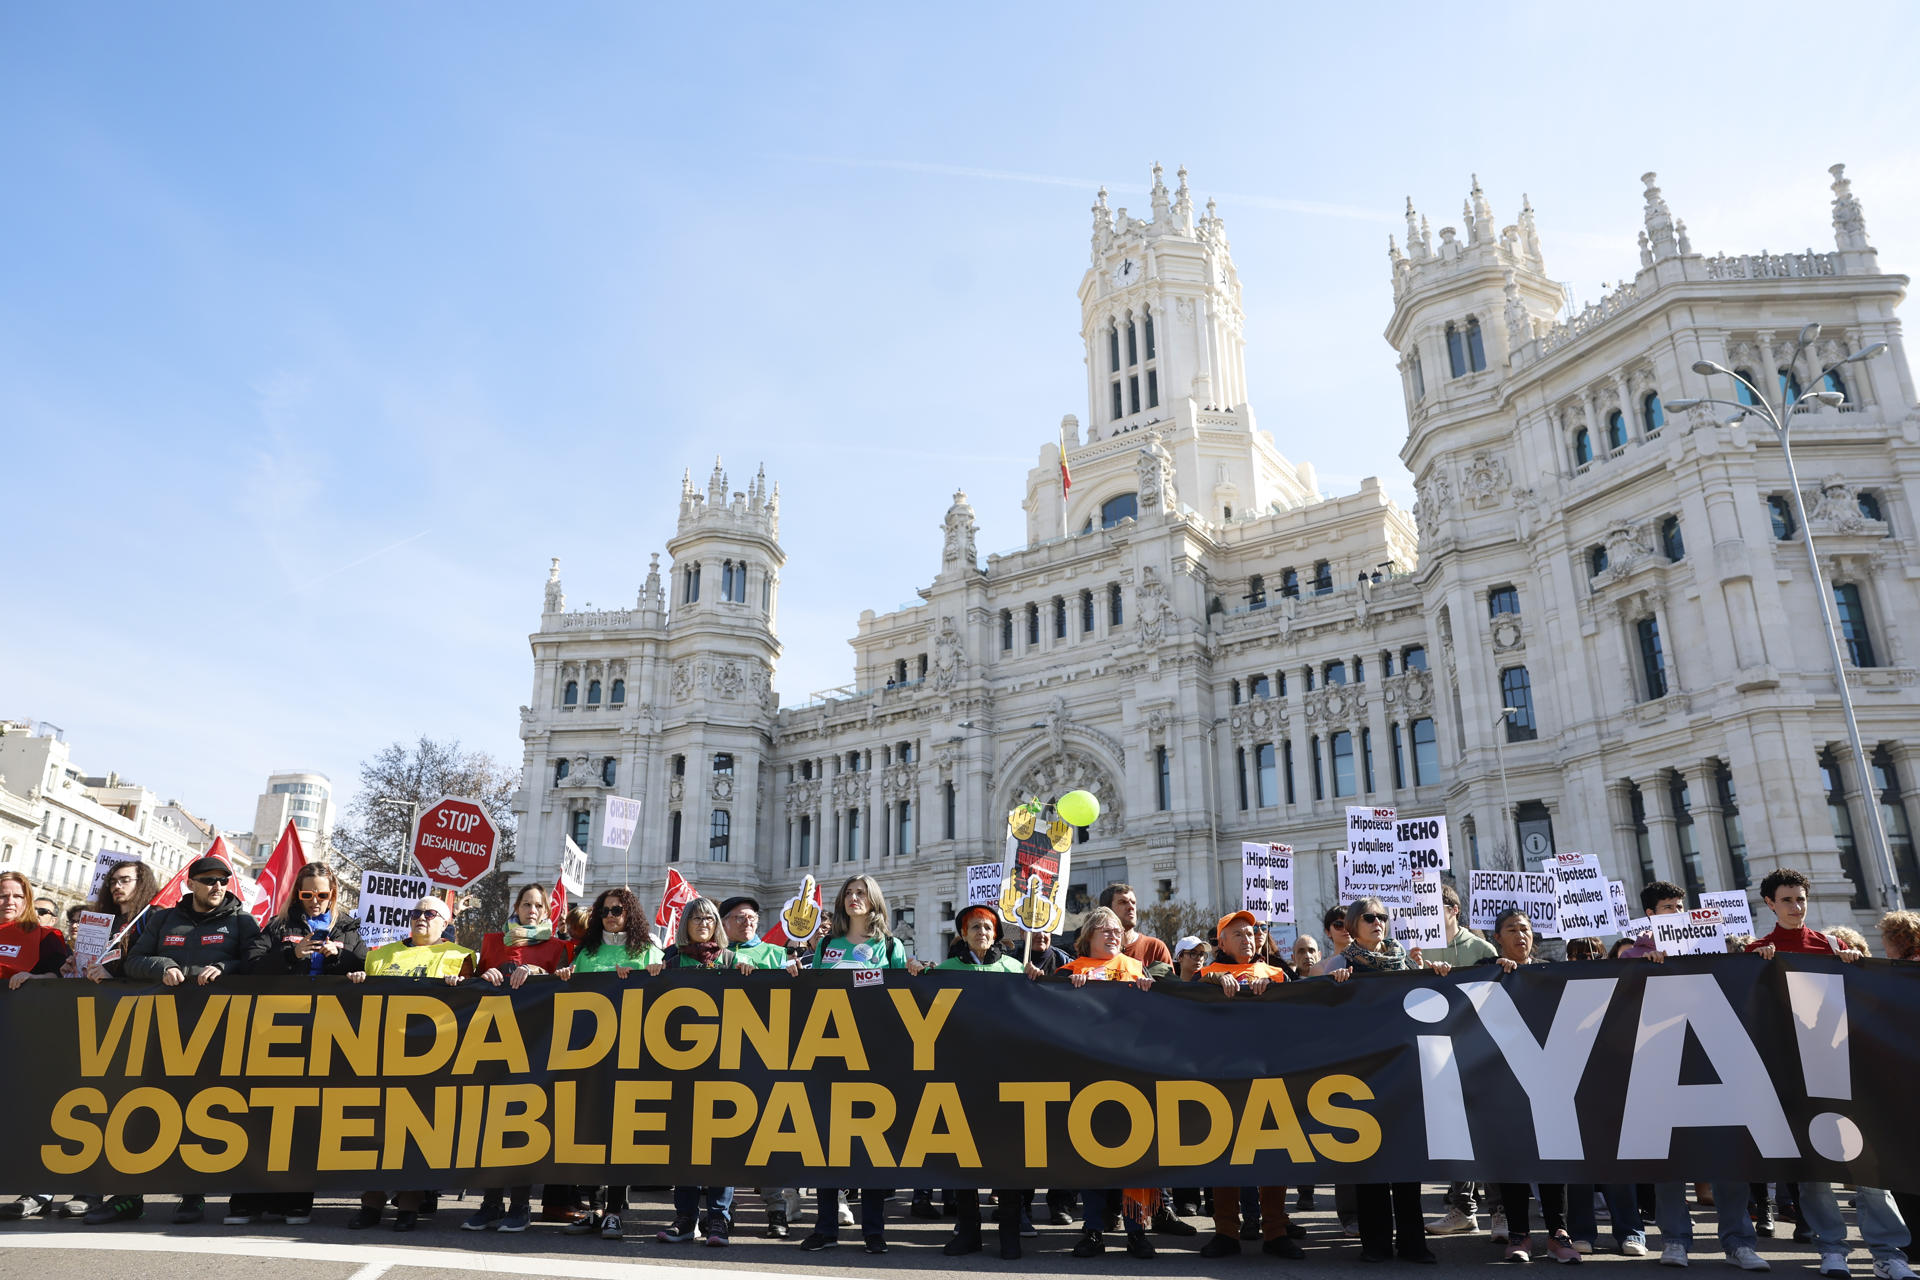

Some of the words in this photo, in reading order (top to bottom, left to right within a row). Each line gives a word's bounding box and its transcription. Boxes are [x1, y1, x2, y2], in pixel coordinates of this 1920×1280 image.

[436, 809, 480, 833] STOP
[1350, 815, 1393, 832] ¡Hipotecas
[1396, 820, 1439, 842] RECHO
[421, 832, 487, 857] DESAHUCIOS
[1351, 841, 1356, 854] y
[1358, 837, 1394, 854] alquileres
[1246, 852, 1289, 869] ¡Hipotecas
[1409, 848, 1443, 869] CHO.
[1352, 860, 1380, 876] justos,
[1381, 861, 1395, 877] ya!
[367, 875, 426, 900] DERECHO
[1246, 877, 1252, 891] y
[1253, 874, 1289, 891] alquileres
[1472, 872, 1515, 895] ¡DERECHO
[1516, 874, 1523, 892] A
[970, 886, 976, 899] A
[1563, 888, 1603, 907] alquileres
[1246, 896, 1273, 913] justos,
[1275, 899, 1289, 915] ya!
[1392, 907, 1398, 921] y
[1472, 899, 1479, 916] A
[1691, 910, 1719, 920] NO+
[366, 904, 375, 923] A
[380, 905, 411, 928] TECH
[1561, 914, 1593, 932] justos,
[1594, 910, 1609, 929] ya!
[1425, 924, 1440, 942] ya!
[1657, 924, 1718, 943] ¡Hipotecas
[855, 971, 881, 980] NO+
[76, 994, 530, 1078] VIVIENDA
[546, 988, 870, 1071] DIGNA
[887, 988, 963, 1071] Y
[1403, 971, 1864, 1163] ¡YA!
[40, 1080, 673, 1174] SOSTENIBLE
[690, 1080, 983, 1168] PARA
[998, 1074, 1382, 1168] TODAS
